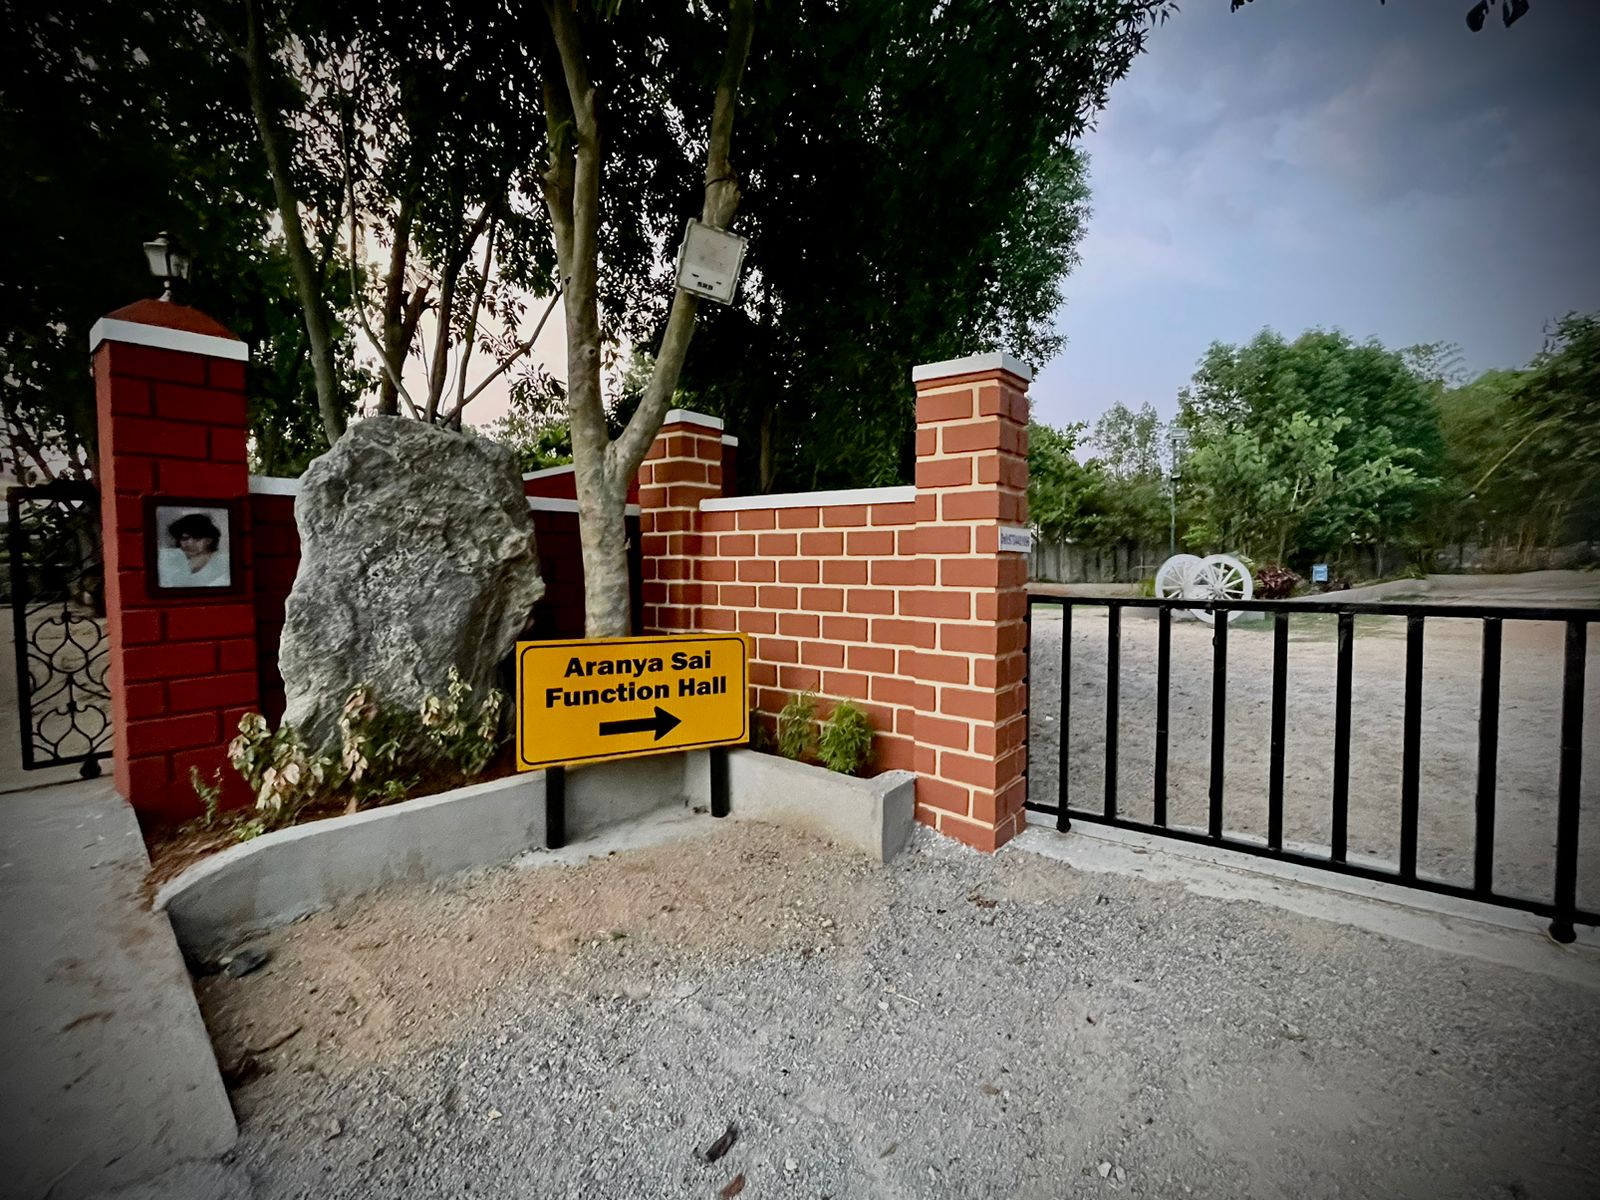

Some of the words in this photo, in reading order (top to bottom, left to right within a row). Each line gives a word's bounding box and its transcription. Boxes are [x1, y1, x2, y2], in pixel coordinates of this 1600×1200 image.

[564, 655, 664, 678] Aranya
[671, 650, 712, 671] Sai
[545, 681, 670, 708] Function
[678, 675, 727, 698] Hall
